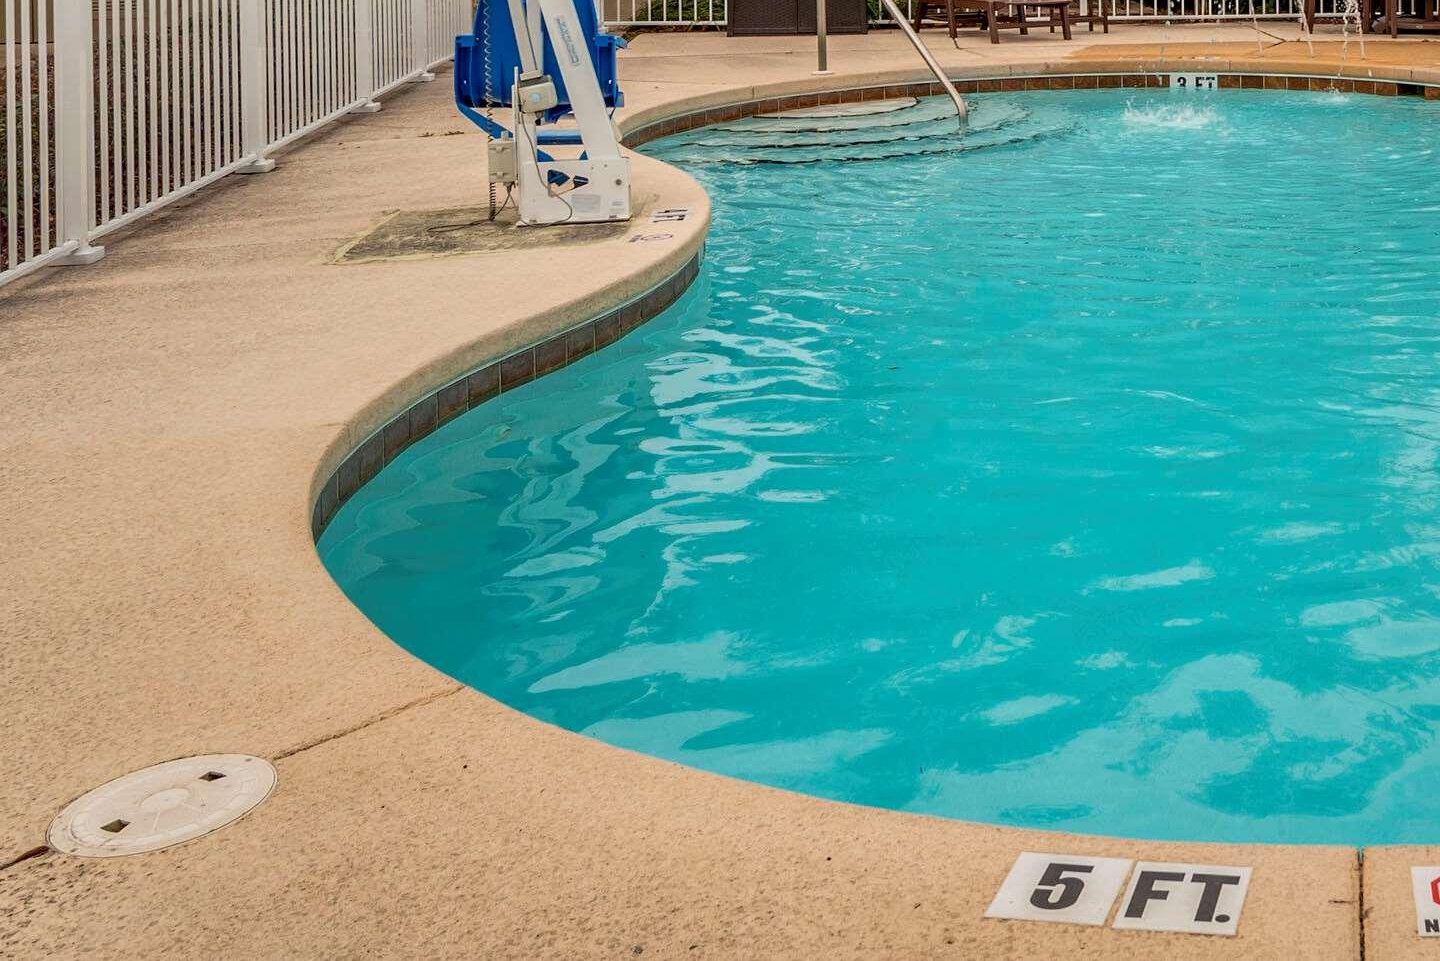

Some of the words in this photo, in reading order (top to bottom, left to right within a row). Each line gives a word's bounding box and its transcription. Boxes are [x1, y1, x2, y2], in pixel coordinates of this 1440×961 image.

[1195, 77, 1215, 88] FT
[1030, 862, 1095, 911] 5
[1124, 870, 1241, 924] FT.
